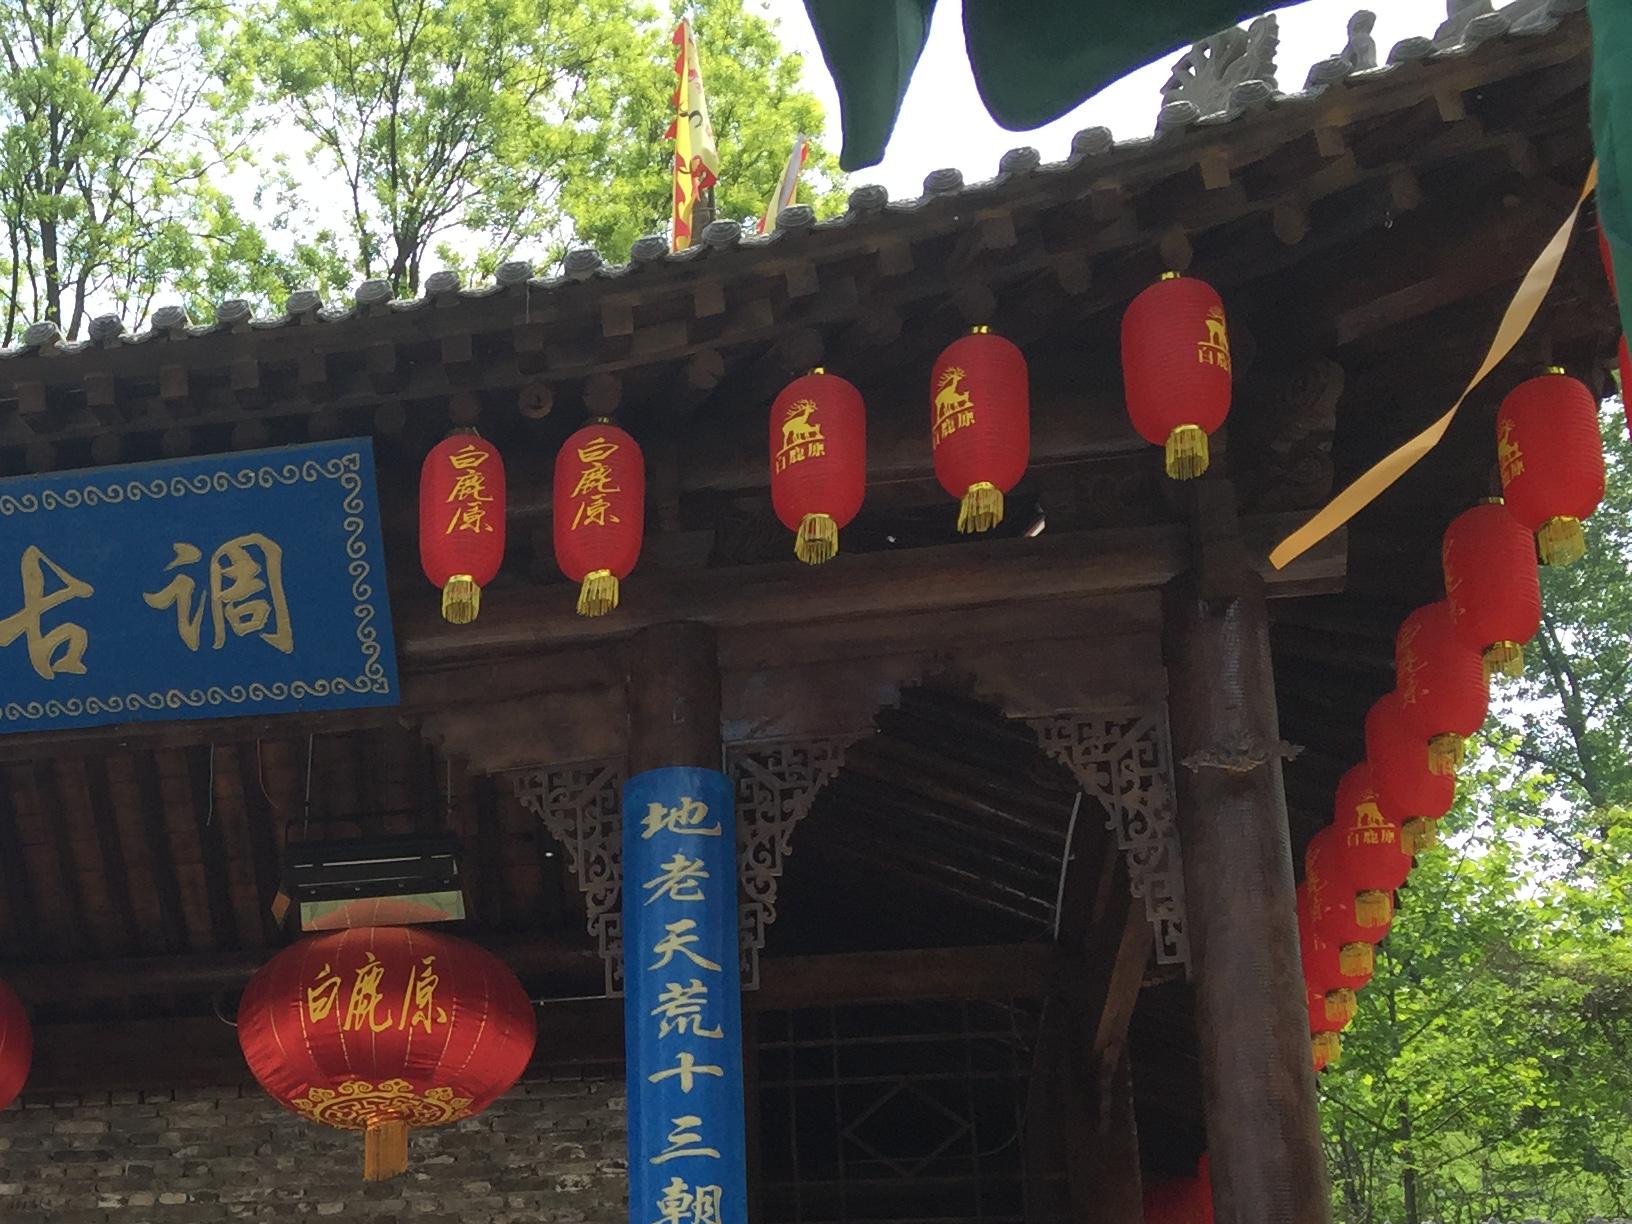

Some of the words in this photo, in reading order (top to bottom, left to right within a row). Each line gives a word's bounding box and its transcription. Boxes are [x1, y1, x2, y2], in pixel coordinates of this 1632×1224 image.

[446, 444, 494, 534] 白鹿原
[570, 437, 621, 531] 白鹿原
[775, 440, 826, 475] 白鹿原
[307, 951, 449, 1035] 白鹿原
